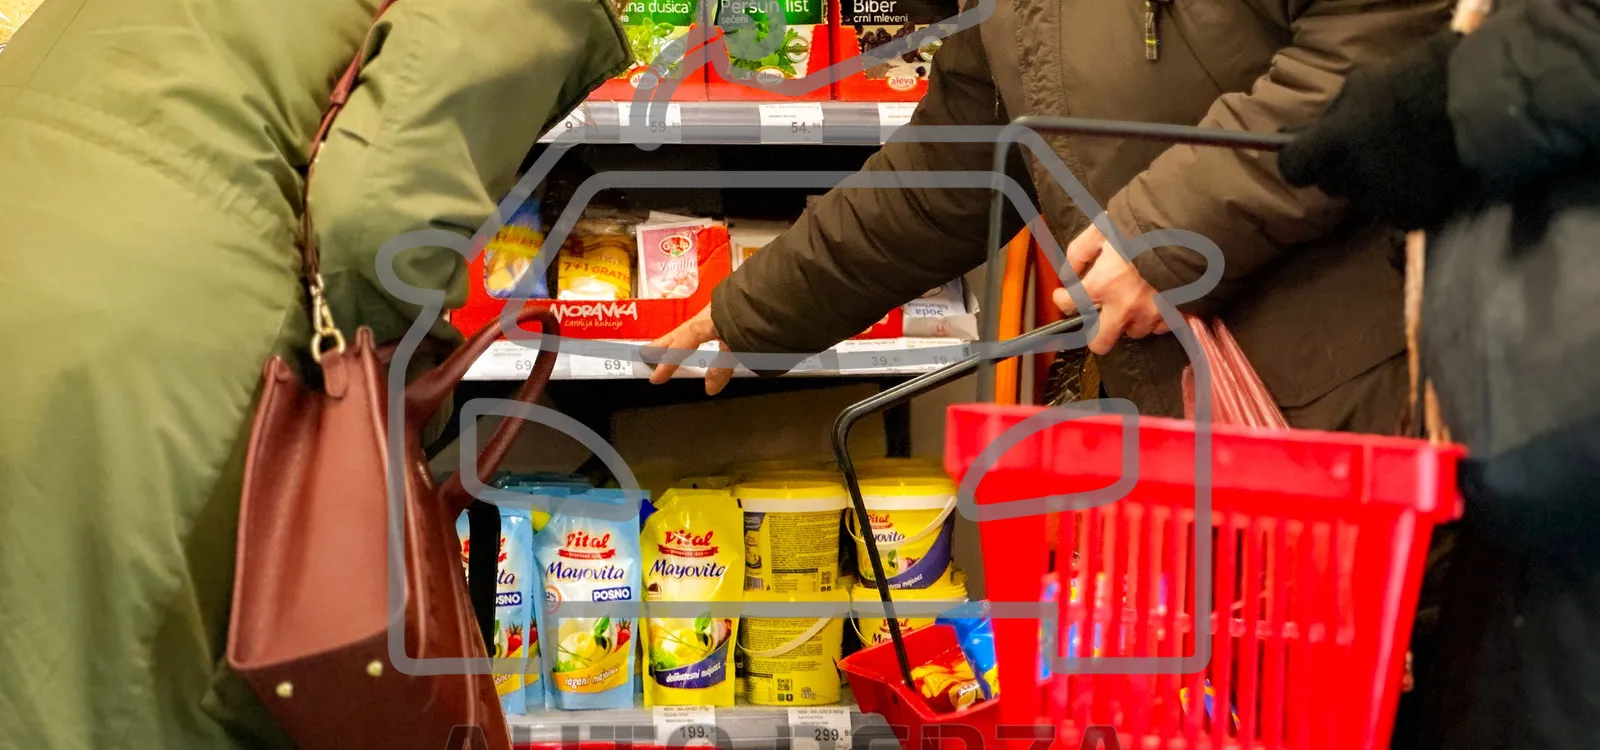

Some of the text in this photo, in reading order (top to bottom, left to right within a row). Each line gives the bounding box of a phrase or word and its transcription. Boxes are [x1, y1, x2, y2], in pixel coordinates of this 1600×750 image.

[648, 0, 688, 13] dušica
[785, 0, 809, 12] list
[853, 0, 897, 13] Biber
[721, 15, 748, 24] sečeni
[853, 13, 909, 23] crni mleveni
[891, 77, 914, 86] aleva
[563, 261, 589, 272] 7+1
[550, 301, 637, 323] MORAVKA
[915, 308, 945, 317] Soda
[566, 531, 610, 548] Vital
[665, 529, 714, 547] Vital
[545, 560, 626, 582] Mayovita
[648, 559, 727, 580] Mayovita
[593, 588, 630, 601] POSNO
[564, 675, 591, 690] lagani
[665, 670, 701, 684] delikatesni
